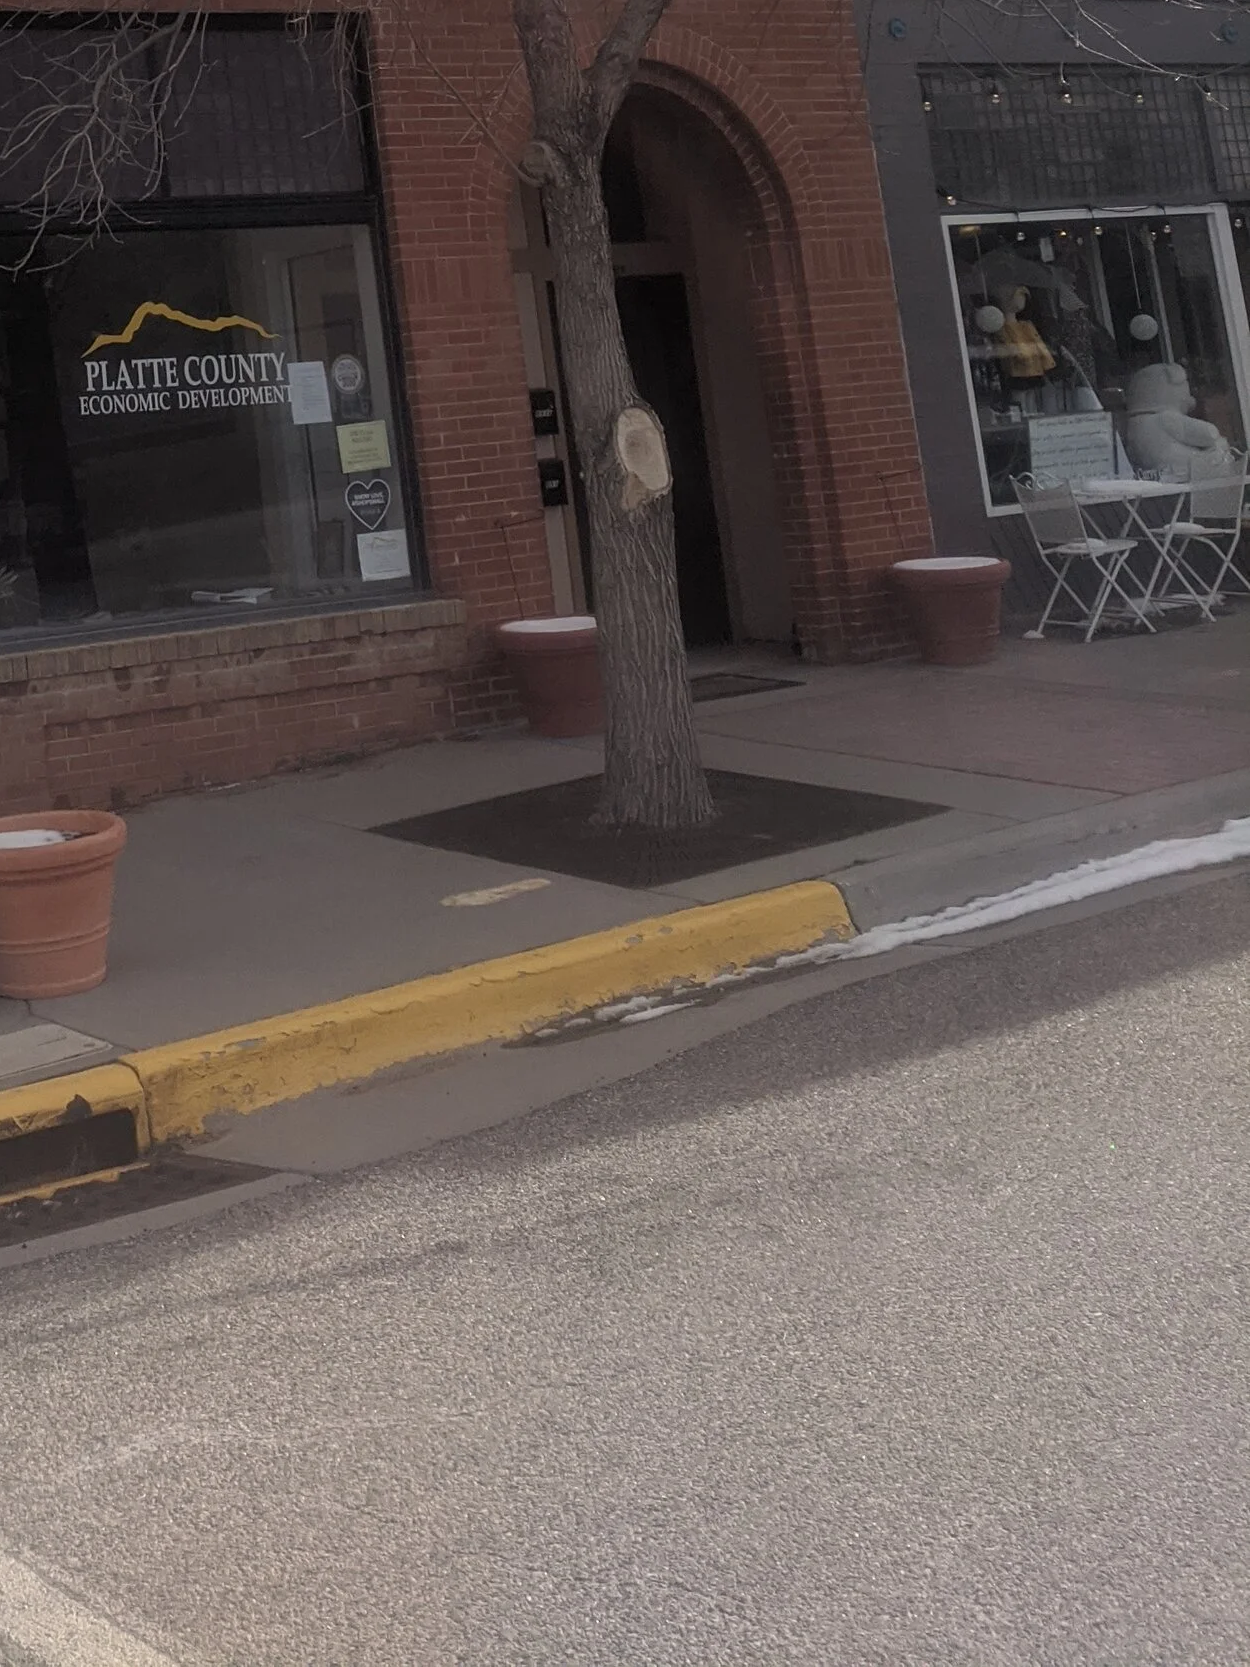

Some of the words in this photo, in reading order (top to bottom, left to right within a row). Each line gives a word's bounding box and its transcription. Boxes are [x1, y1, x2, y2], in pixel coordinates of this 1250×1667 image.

[84, 357, 179, 392] PLATTE
[183, 351, 286, 386] COUNTY
[79, 392, 171, 416] ECONOMIC
[178, 383, 294, 410] DEVELOPMENT
